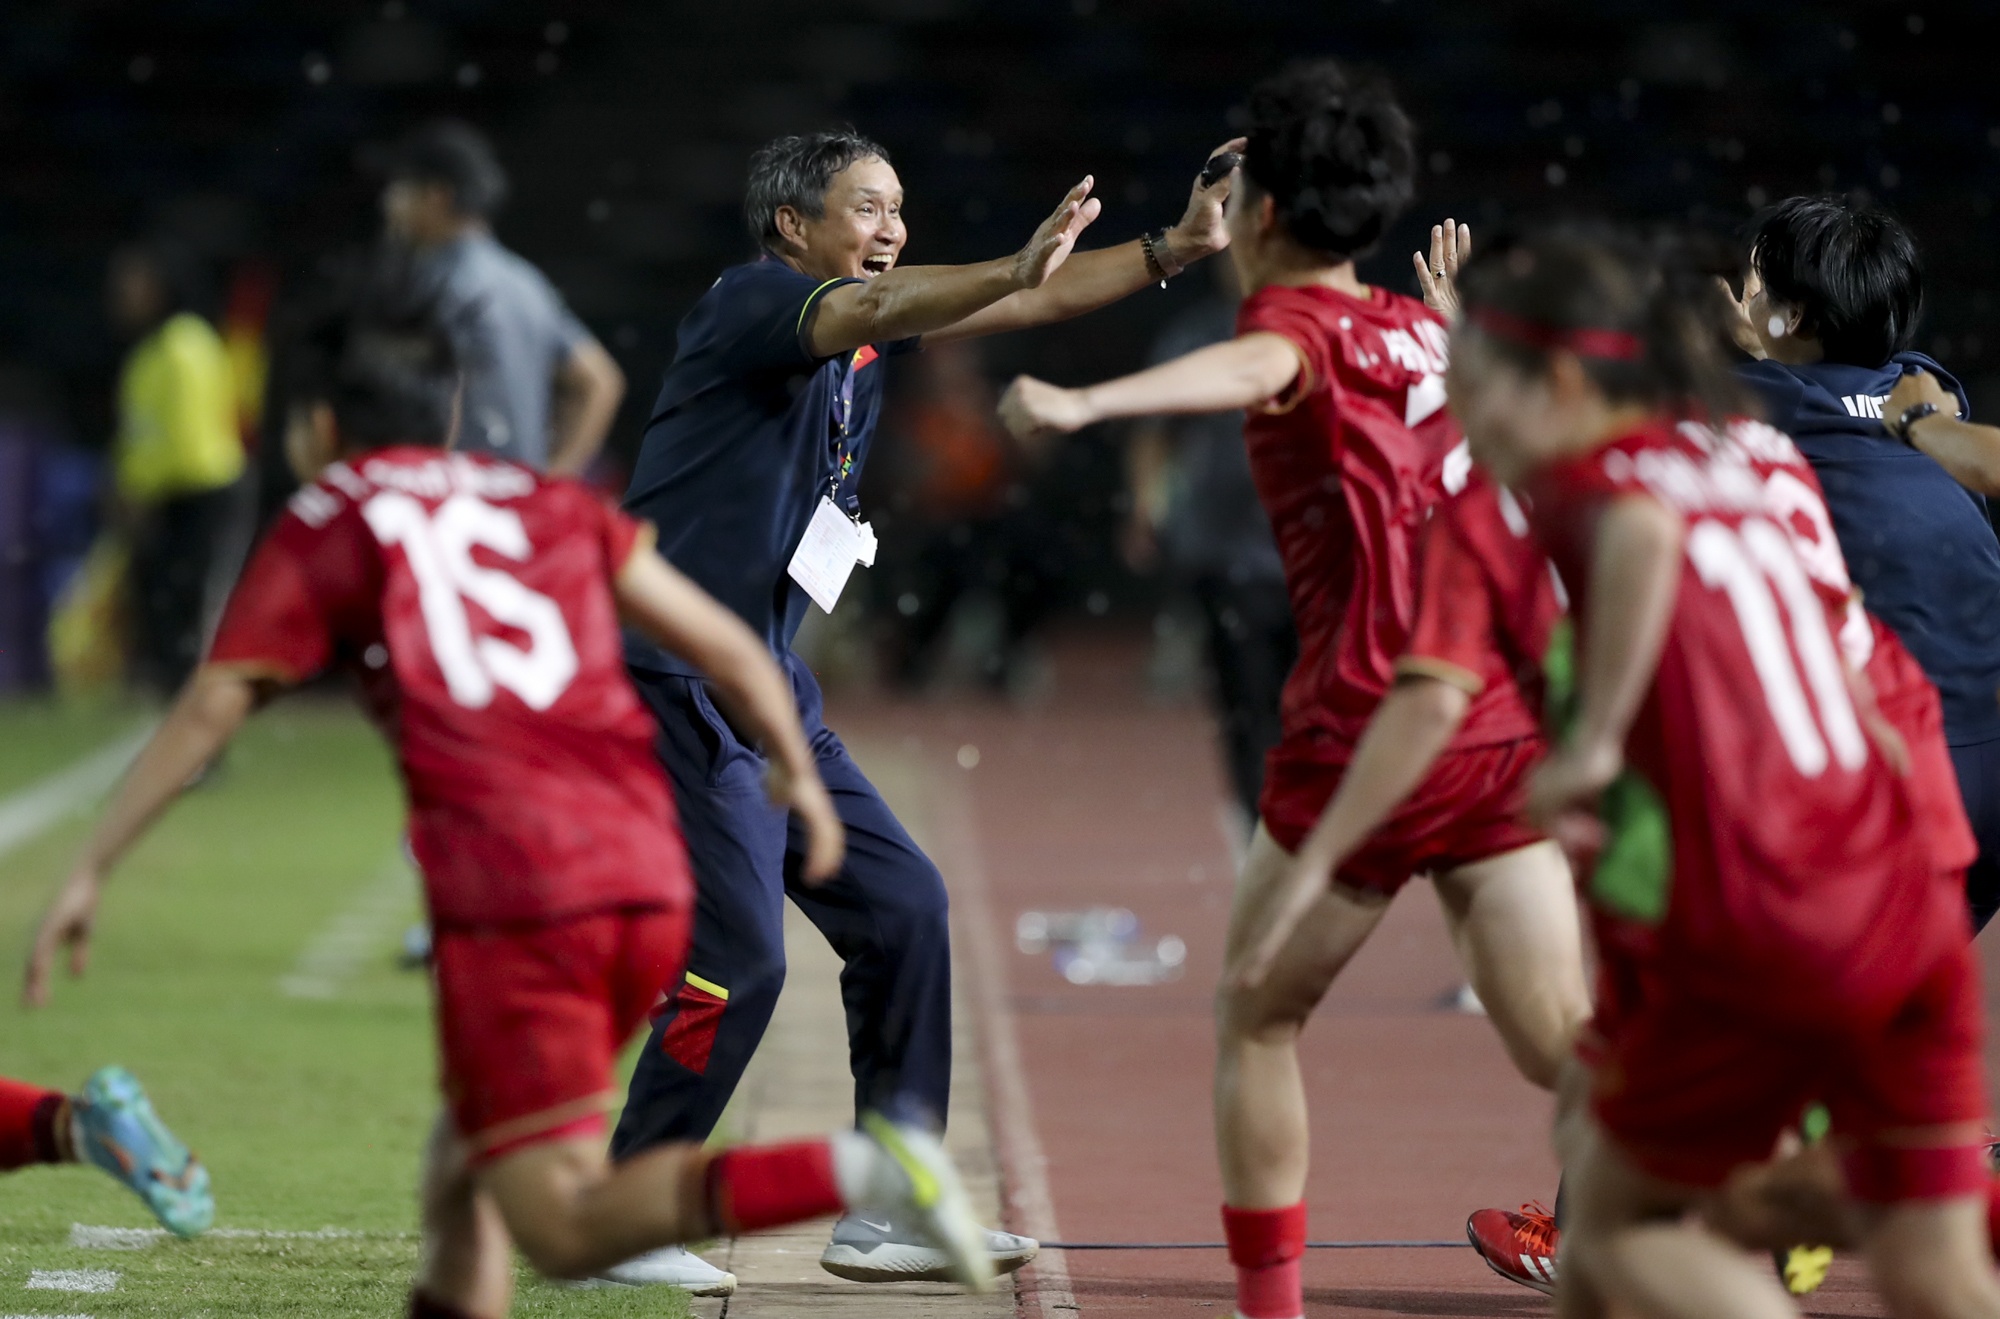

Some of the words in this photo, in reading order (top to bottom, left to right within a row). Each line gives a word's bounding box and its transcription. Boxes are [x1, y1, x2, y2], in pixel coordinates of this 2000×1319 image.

[1841, 394, 1892, 419] VIE
[362, 490, 578, 711] 15
[1688, 518, 1868, 777] 11
